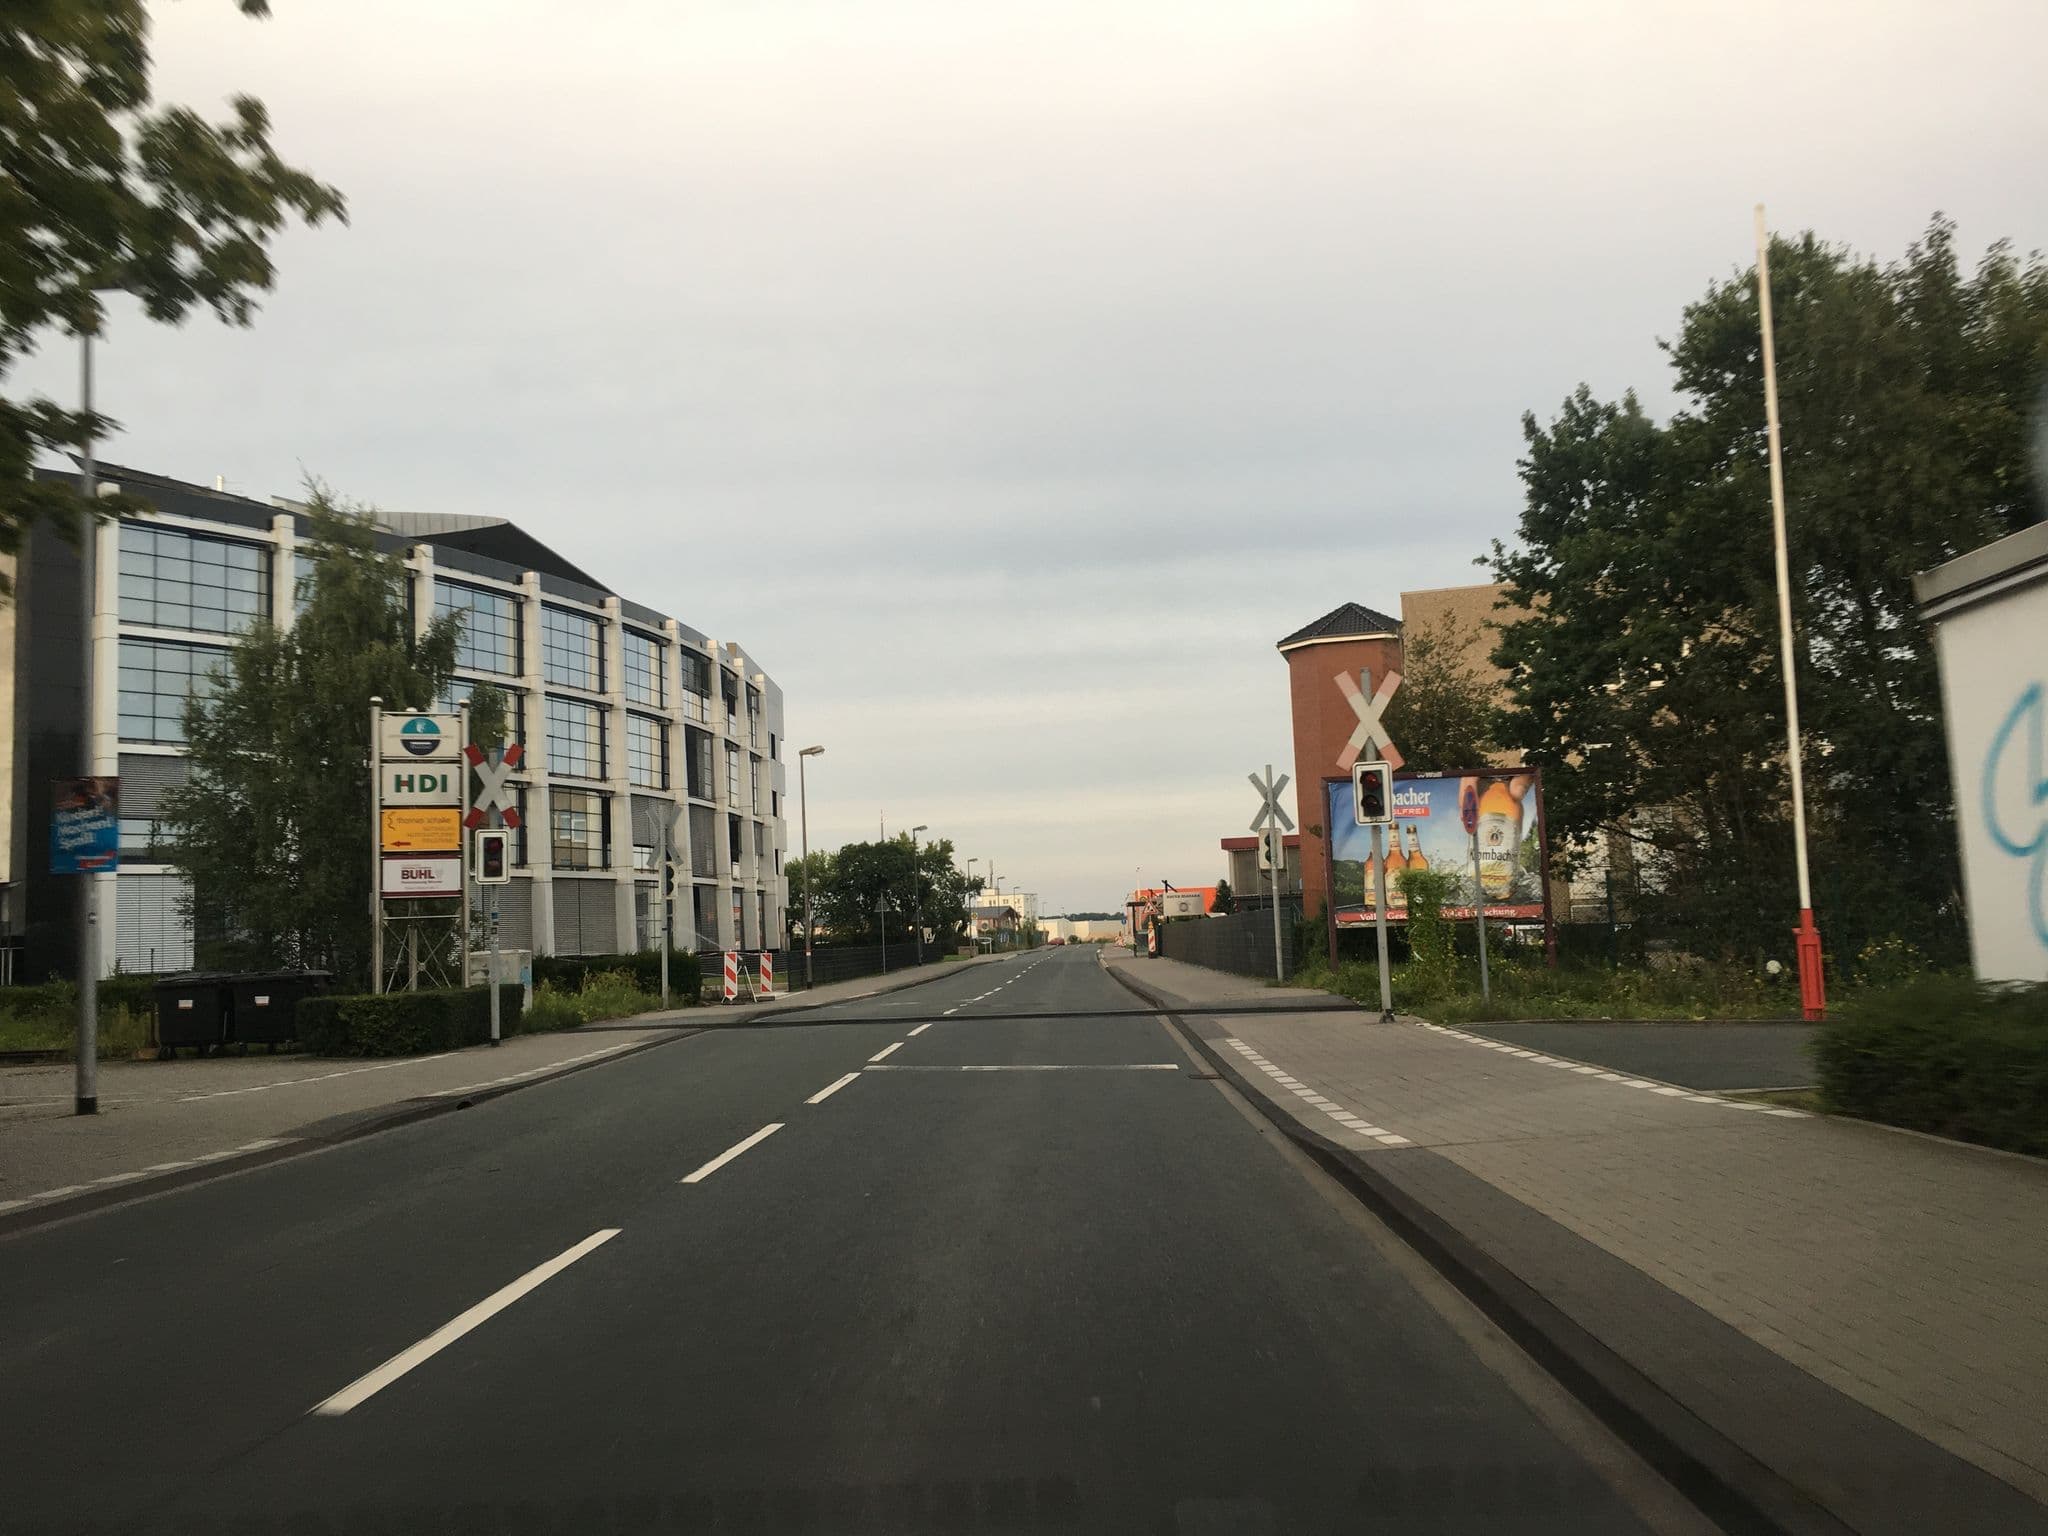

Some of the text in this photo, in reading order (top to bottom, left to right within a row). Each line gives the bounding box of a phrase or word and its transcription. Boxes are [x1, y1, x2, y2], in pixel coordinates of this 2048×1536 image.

[394, 774, 448, 793] HDI
[400, 869, 435, 880] BUHL
[1359, 911, 1377, 921] Voll
